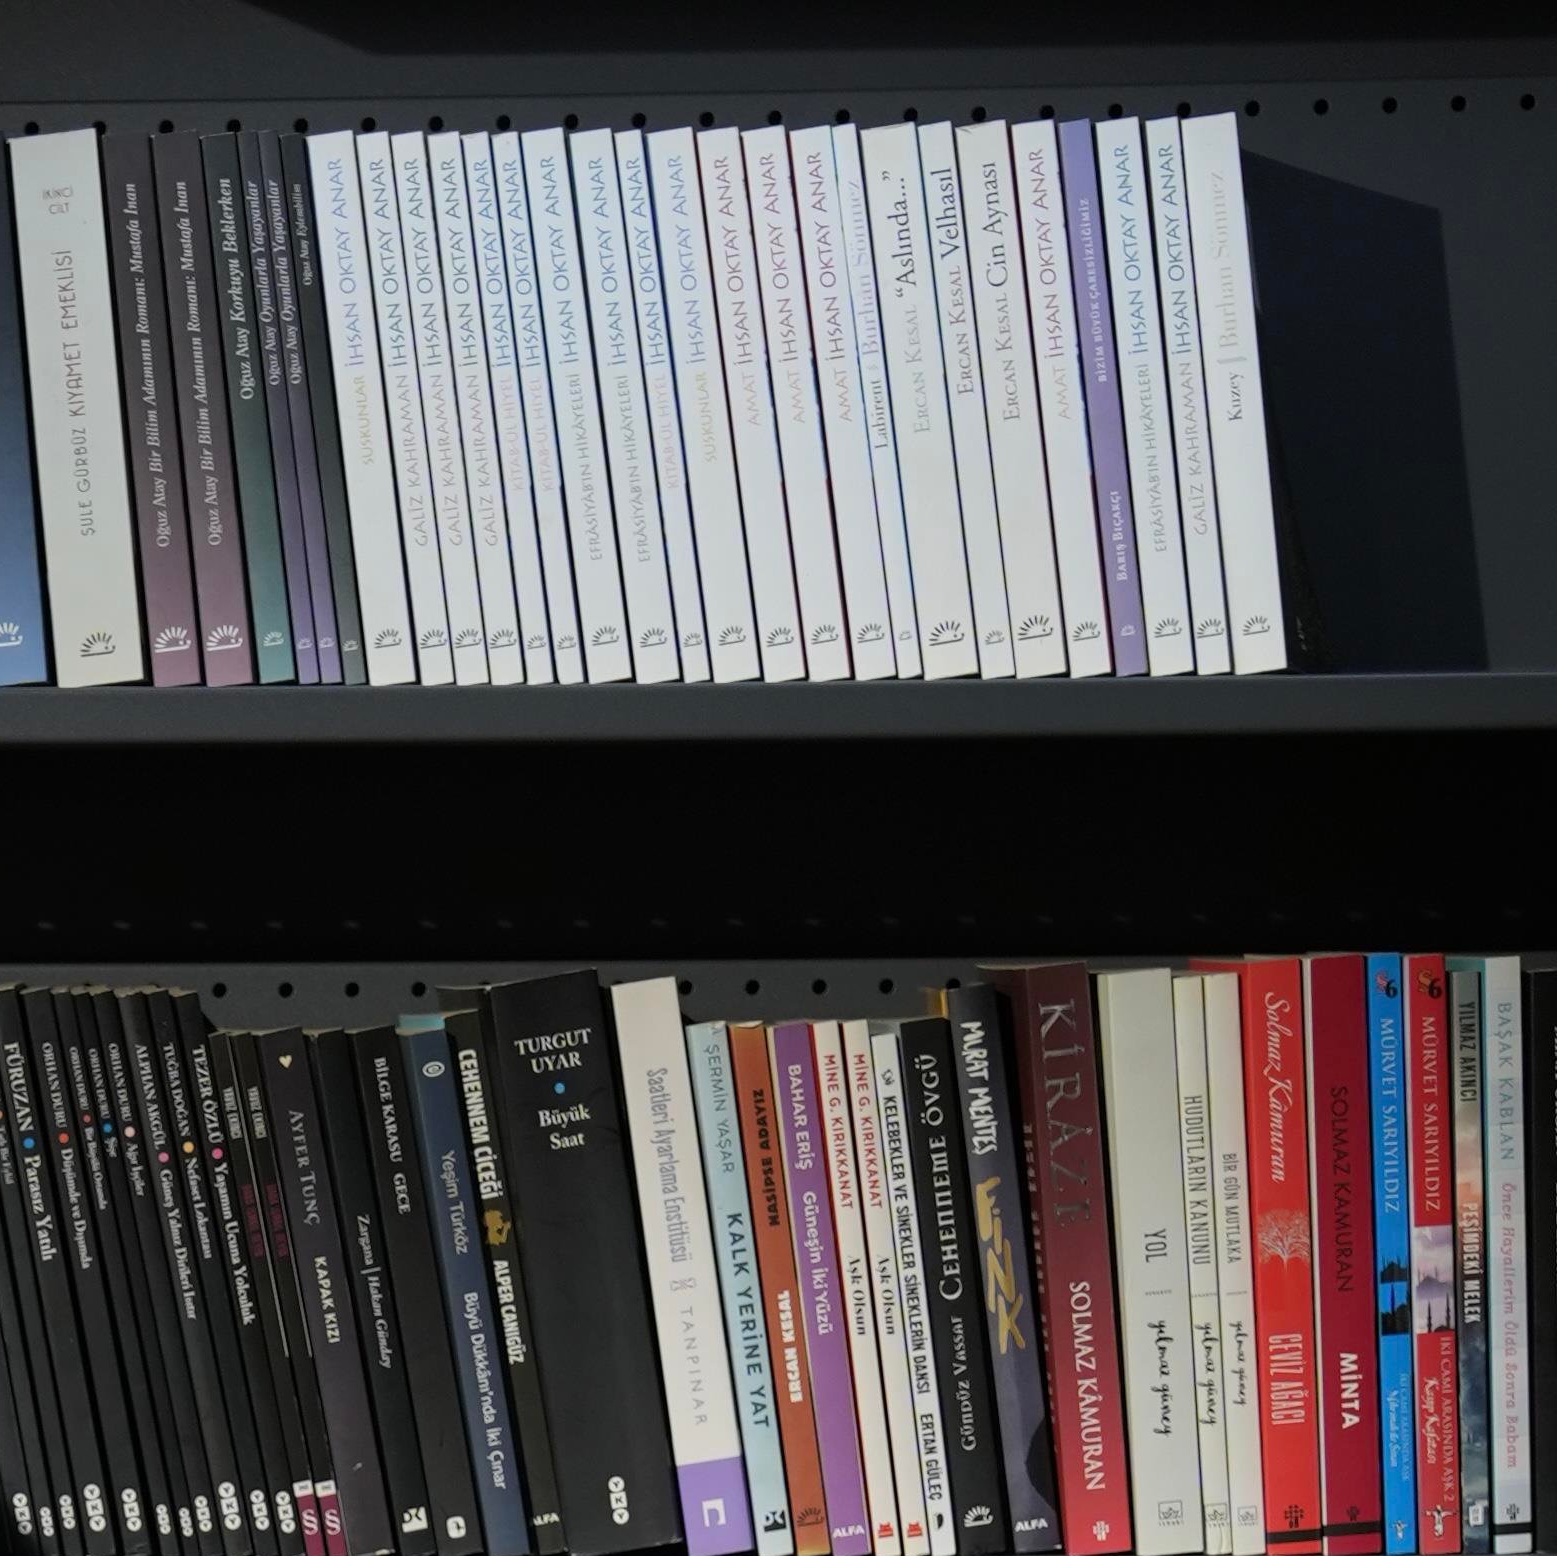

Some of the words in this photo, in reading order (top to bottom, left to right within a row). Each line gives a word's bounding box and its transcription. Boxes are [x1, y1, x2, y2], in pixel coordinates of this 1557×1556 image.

[369, 157, 389, 219] ANAR
[56, 248, 79, 330] EMEKLİSİ
[378, 223, 399, 295] OKTAY
[385, 302, 407, 368] İHSAN
[63, 338, 86, 419] KIYAMET
[73, 427, 91, 493] GÜRBÜZ
[514, 1028, 593, 1057] TURGUT
[530, 1050, 582, 1074] UYAR
[1380, 1017, 1400, 1098] MÜRVET
[538, 1106, 591, 1129] Büyük
[646, 1067, 669, 1127] Saatleri
[787, 1064, 808, 1121] BAHAR
[459, 1048, 490, 1143] CEHENNEM
[475, 1146, 501, 1201] ÇİÇEĞİ
[549, 1130, 586, 1150] Saat
[795, 1125, 814, 1171] ERİŞ
[655, 1130, 678, 1200] Ayarlama
[1382, 1105, 1401, 1213] SARIYILDIZ
[298, 1171, 320, 1227] TUNÇ
[801, 1191, 826, 1259] Güneşin
[664, 1200, 688, 1263] Enstitüsü
[725, 1211, 752, 1277] KALK
[1144, 1228, 1169, 1264] YOL
[313, 1256, 335, 1305] KAPAK
[812, 1261, 826, 1285] İki
[322, 1310, 341, 1344] KIZI
[736, 1283, 763, 1375] YERİNE
[814, 1286, 832, 1336] Yüzü
[1068, 1280, 1097, 1374] SOLMAZ
[747, 1383, 768, 1429] YAT
[1338, 1352, 1360, 1430] MİNTA
[1077, 1377, 1106, 1491] KÂMURAN
